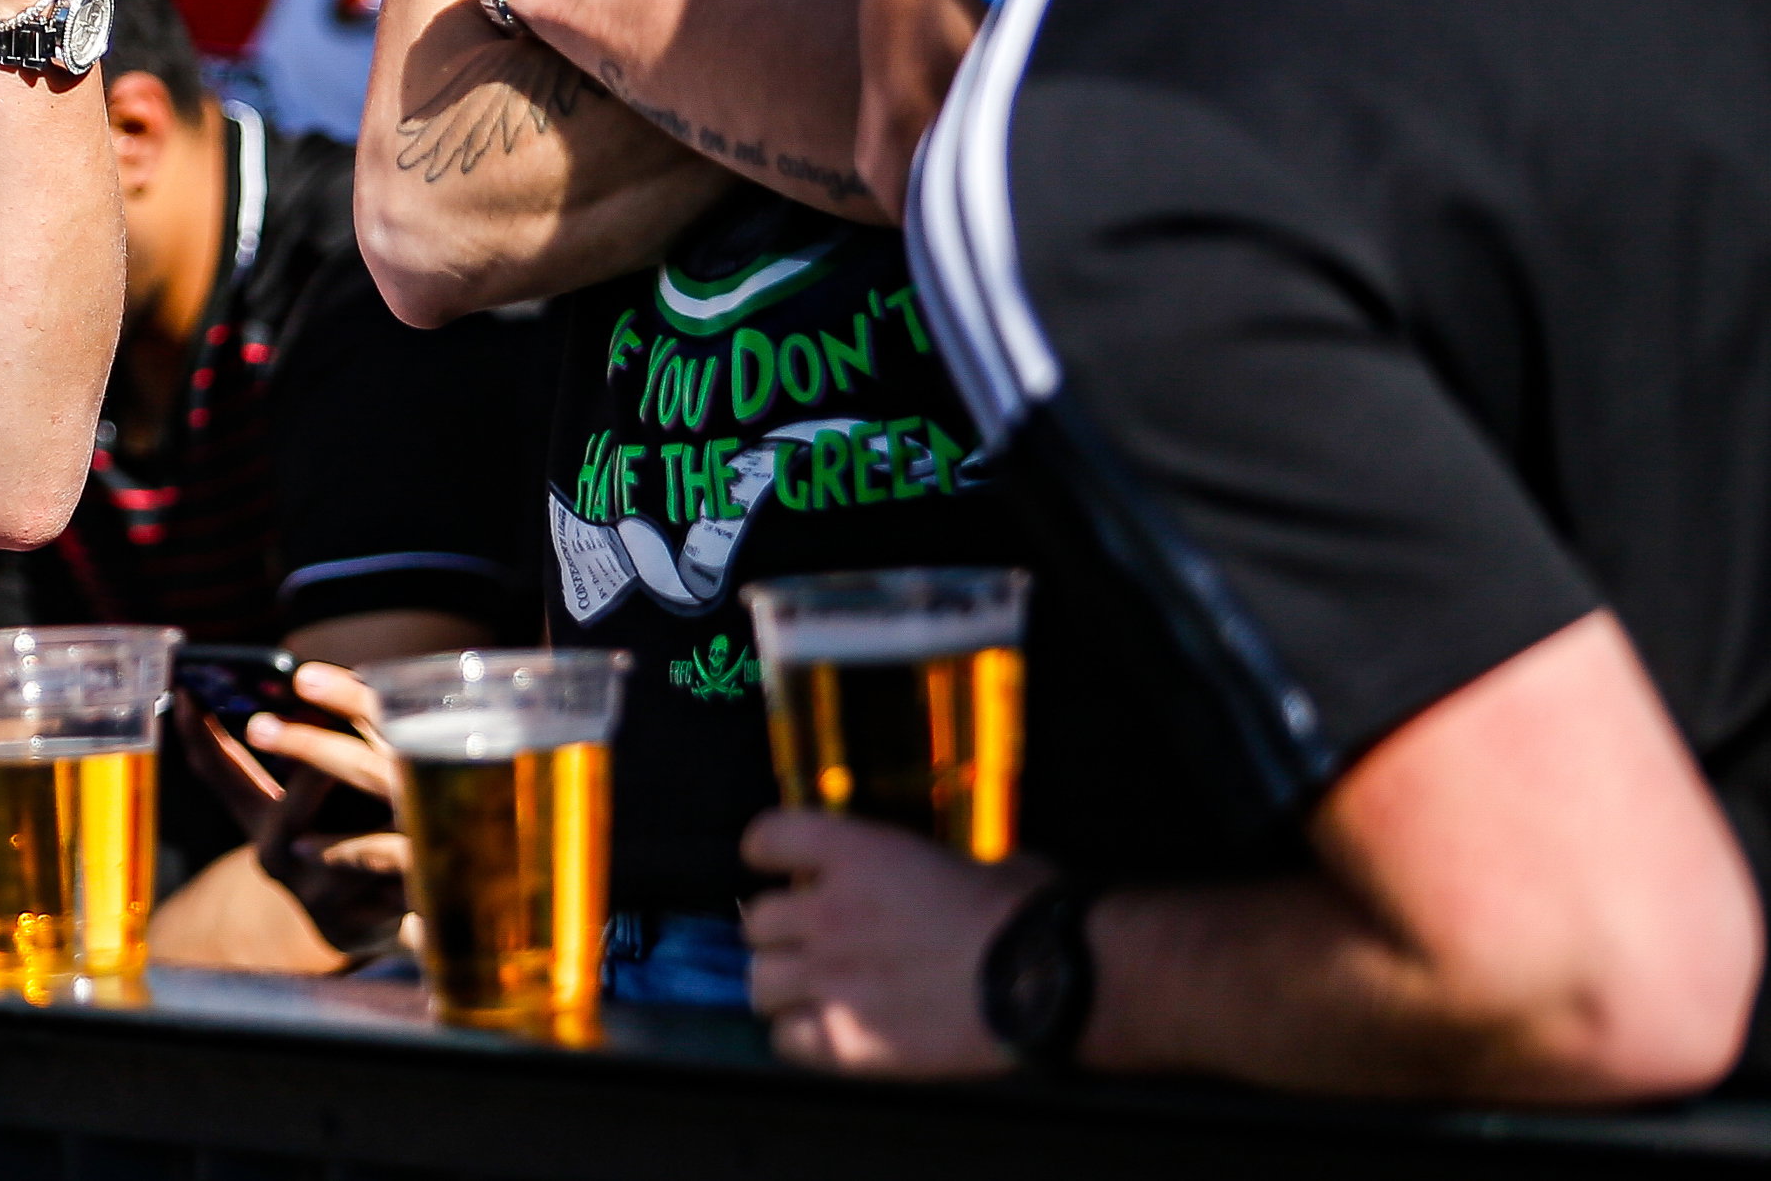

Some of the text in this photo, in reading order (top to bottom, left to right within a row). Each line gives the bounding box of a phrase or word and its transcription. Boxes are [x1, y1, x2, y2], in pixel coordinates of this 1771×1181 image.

[639, 334, 717, 427] YOU
[731, 286, 930, 420] DON'T
[660, 436, 745, 523] THE
